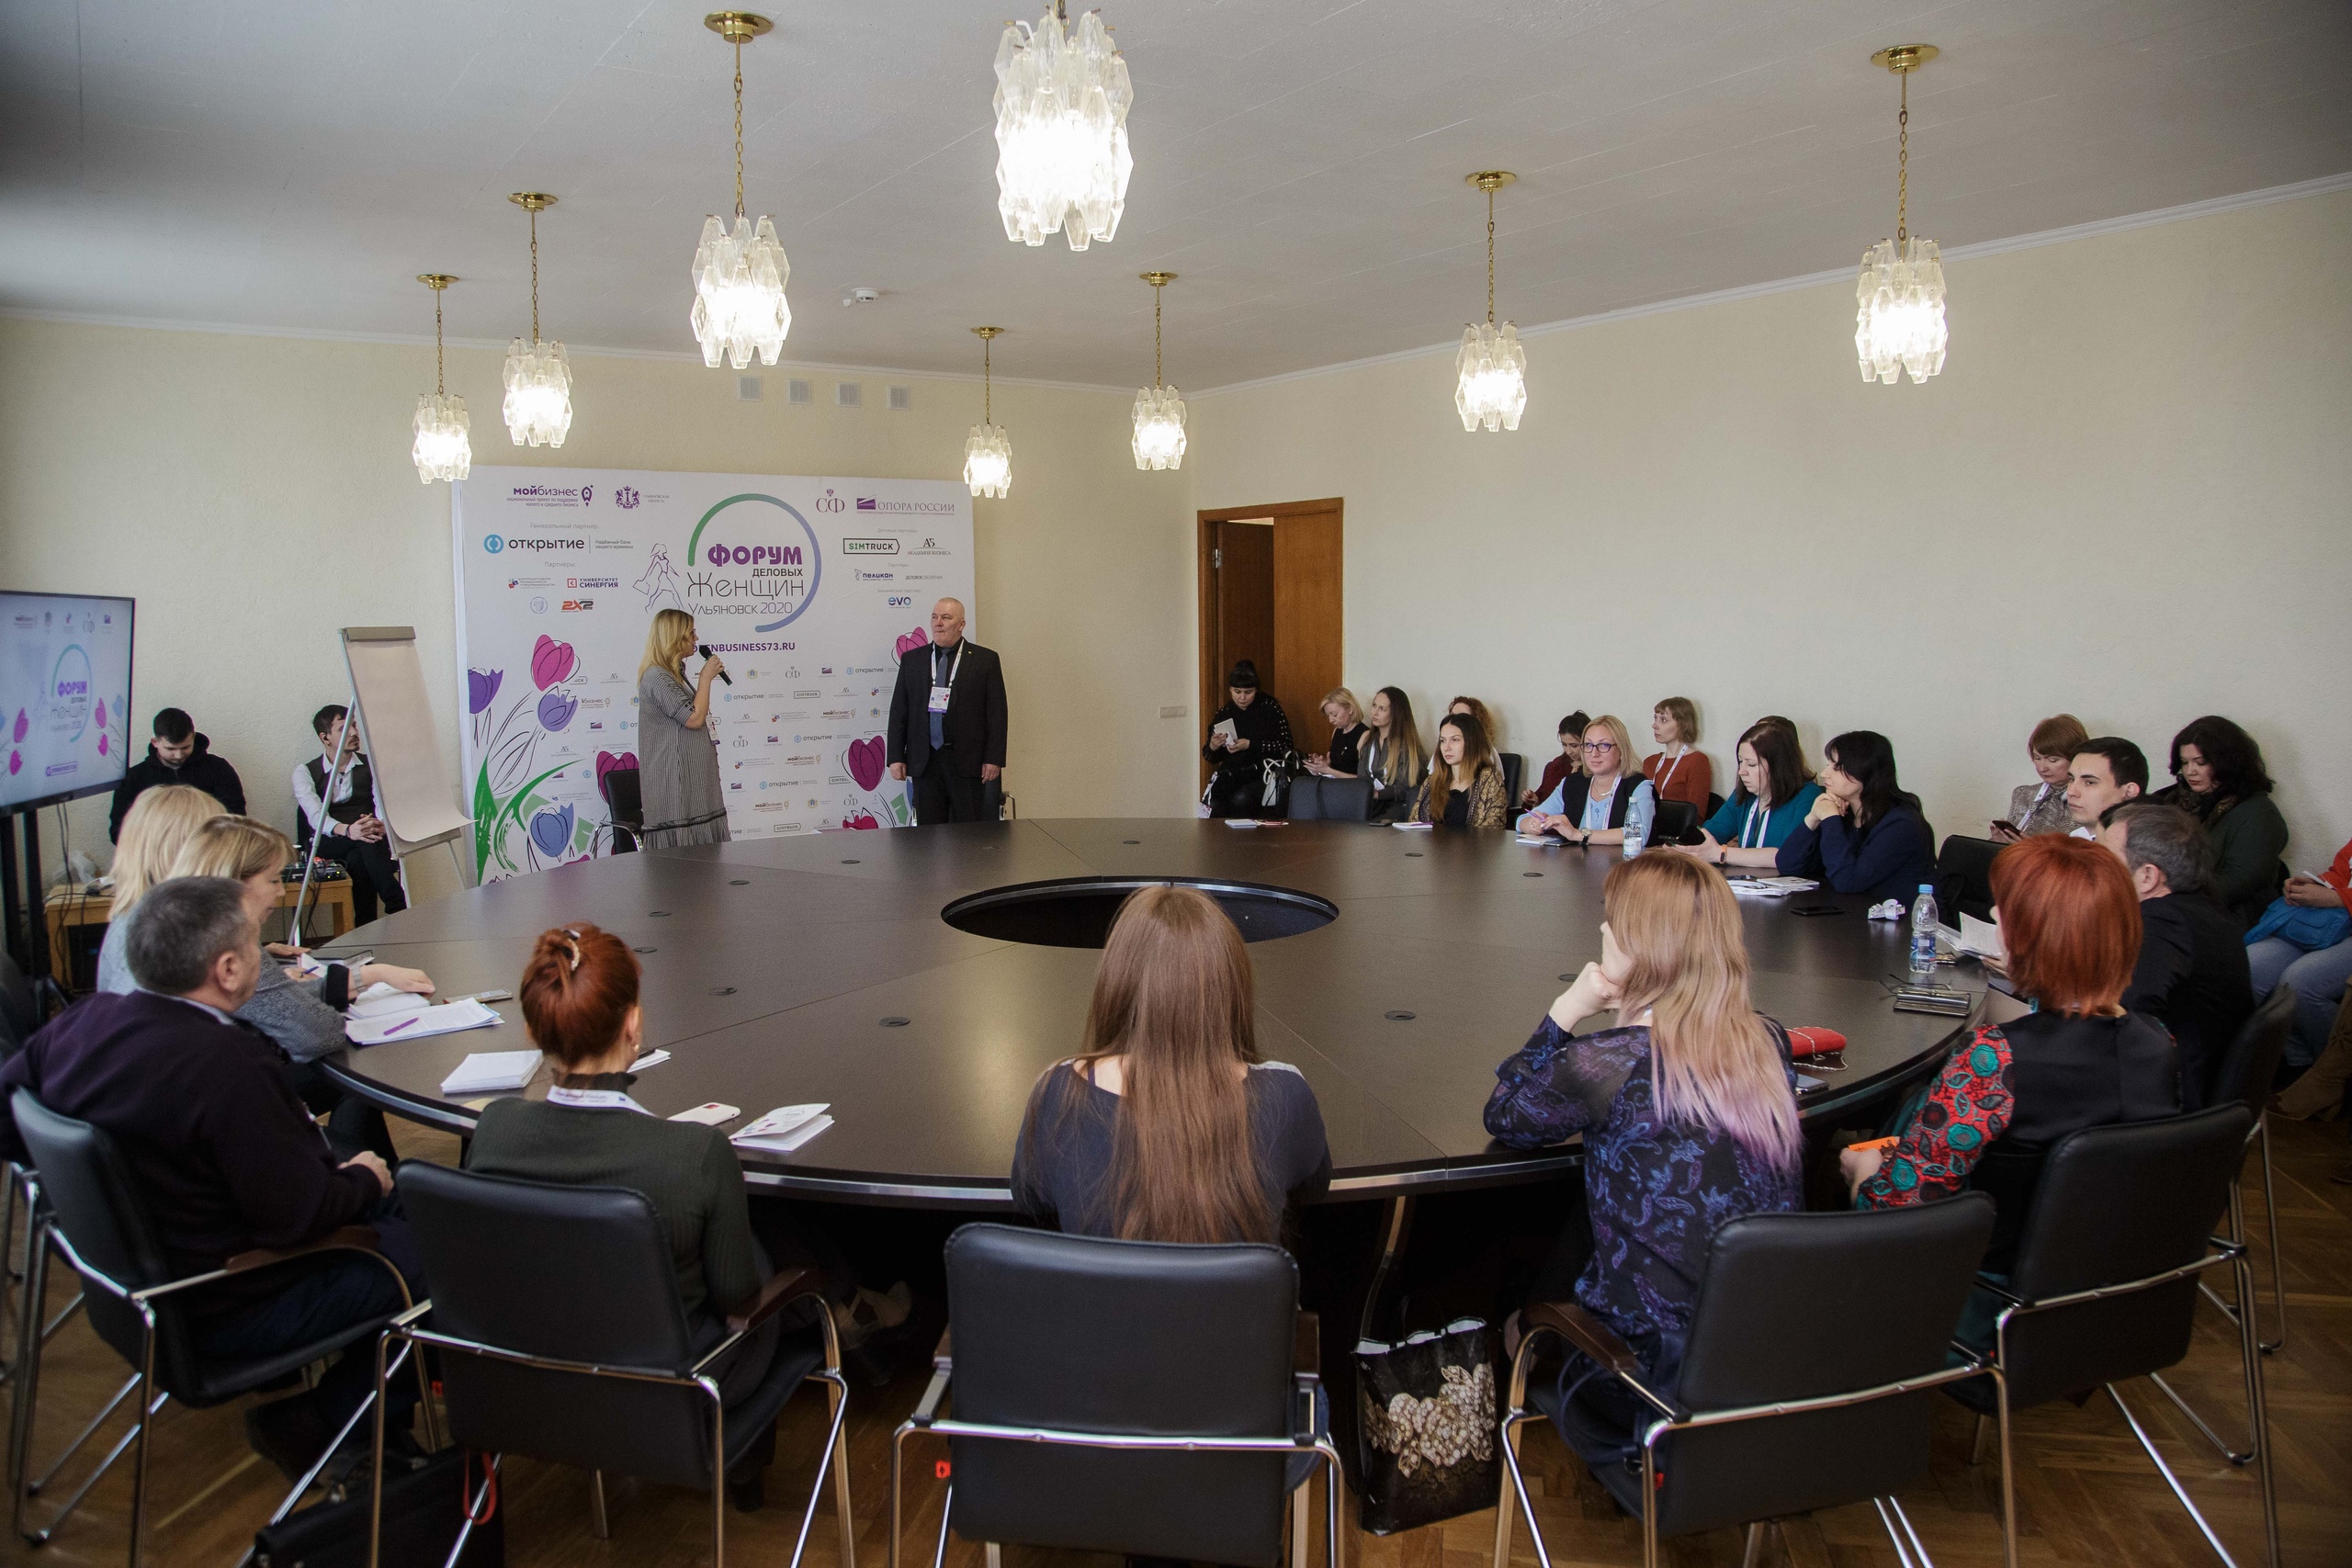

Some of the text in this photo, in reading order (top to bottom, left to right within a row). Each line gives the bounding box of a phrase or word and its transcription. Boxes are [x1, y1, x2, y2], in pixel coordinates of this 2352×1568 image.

[513, 485, 579, 496] мойбизнес
[816, 497, 845, 513] СФ
[877, 502, 955, 512] ОПОРА РОССИИ
[508, 539, 585, 552] открытие
[707, 544, 802, 567] ФОРУМ
[752, 569, 803, 578] ДЕЛОВЫХ
[687, 572, 804, 600] Женщин
[760, 602, 793, 614] 2020
